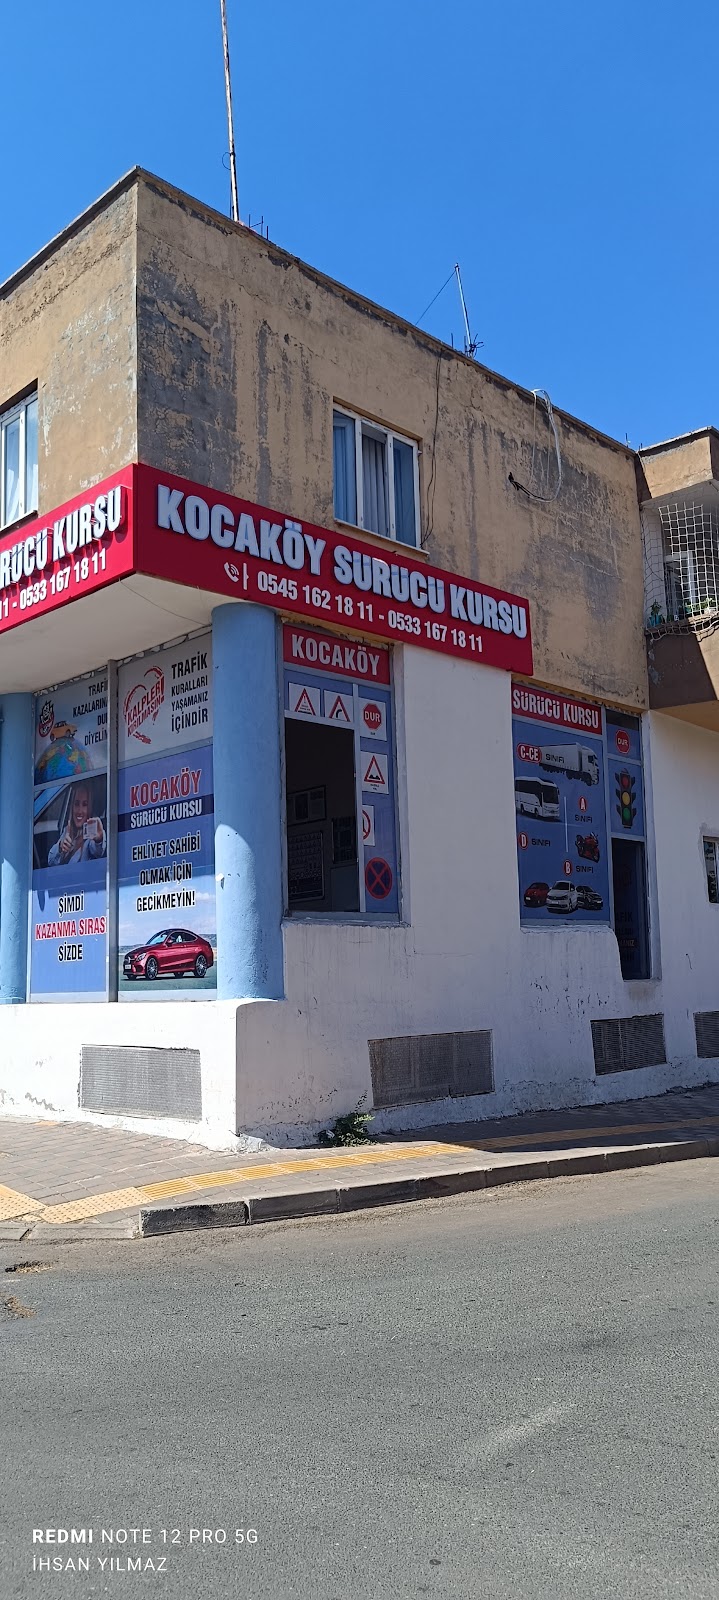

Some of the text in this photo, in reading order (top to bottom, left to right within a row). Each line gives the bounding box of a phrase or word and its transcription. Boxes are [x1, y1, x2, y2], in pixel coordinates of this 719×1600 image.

[53, 486, 121, 561] KURSU
[157, 484, 326, 576] KOCAKÖY
[450, 584, 527, 638] KURSU
[20, 579, 47, 610] 0533
[50, 567, 71, 595] 167
[74, 557, 89, 583] 18
[92, 548, 107, 574] 11
[257, 571, 298, 600] 0545
[302, 584, 331, 610] 162
[335, 594, 353, 616] 18
[357, 601, 374, 622] 11
[388, 609, 421, 636] 0533
[424, 620, 448, 642] 167
[451, 628, 467, 648] 18
[469, 634, 483, 652] 11
[171, 651, 208, 679] TRAFİK
[291, 633, 380, 676] KOCAKÖY
[171, 675, 208, 697] KURALLARI
[171, 691, 209, 712] YAŞAMANIZ
[513, 689, 599, 729] SÜRÜCÜ KURSU
[171, 708, 208, 734] İÇİNDİR
[364, 711, 381, 722] DUR
[520, 746, 539, 762] C-CE
[617, 737, 629, 746] DUR
[130, 767, 202, 808] KOCAKÖY
[130, 799, 202, 829] SÜRÜCÜ KURSU
[580, 797, 586, 811] A
[132, 831, 201, 862] EHLİYET SAHİBİ
[520, 833, 527, 849] D
[139, 860, 192, 887] OLMAK İÇİN
[565, 860, 571, 875] B
[58, 891, 84, 917] ŞİMDİ
[136, 890, 196, 912] GECİKMEYİN!
[35, 920, 76, 940] KAZANMA
[58, 942, 83, 962] SİZDE
